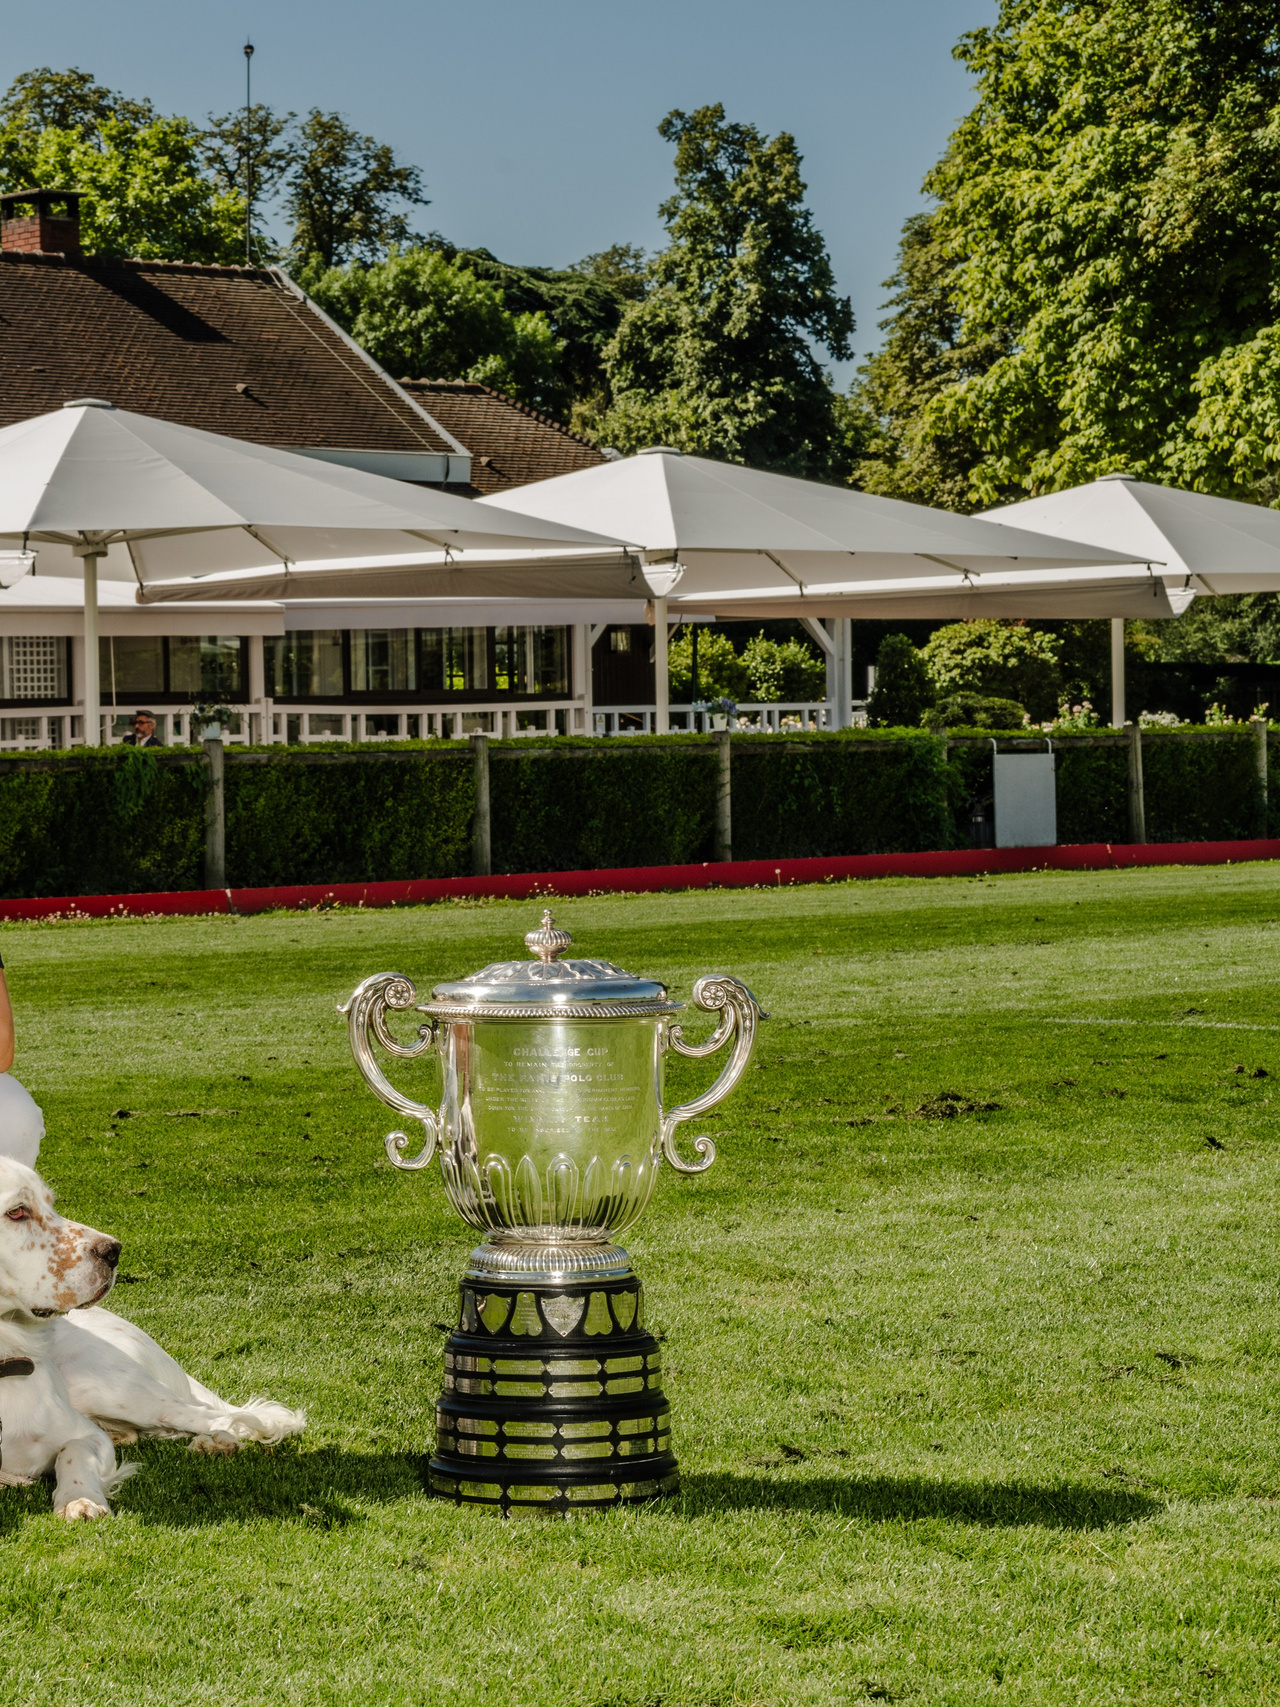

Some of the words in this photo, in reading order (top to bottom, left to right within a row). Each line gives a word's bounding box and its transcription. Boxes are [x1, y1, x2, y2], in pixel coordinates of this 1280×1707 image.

[586, 1048, 609, 1057] CUP
[564, 1074, 593, 1082] POLO
[596, 1073, 624, 1081] CLUB
